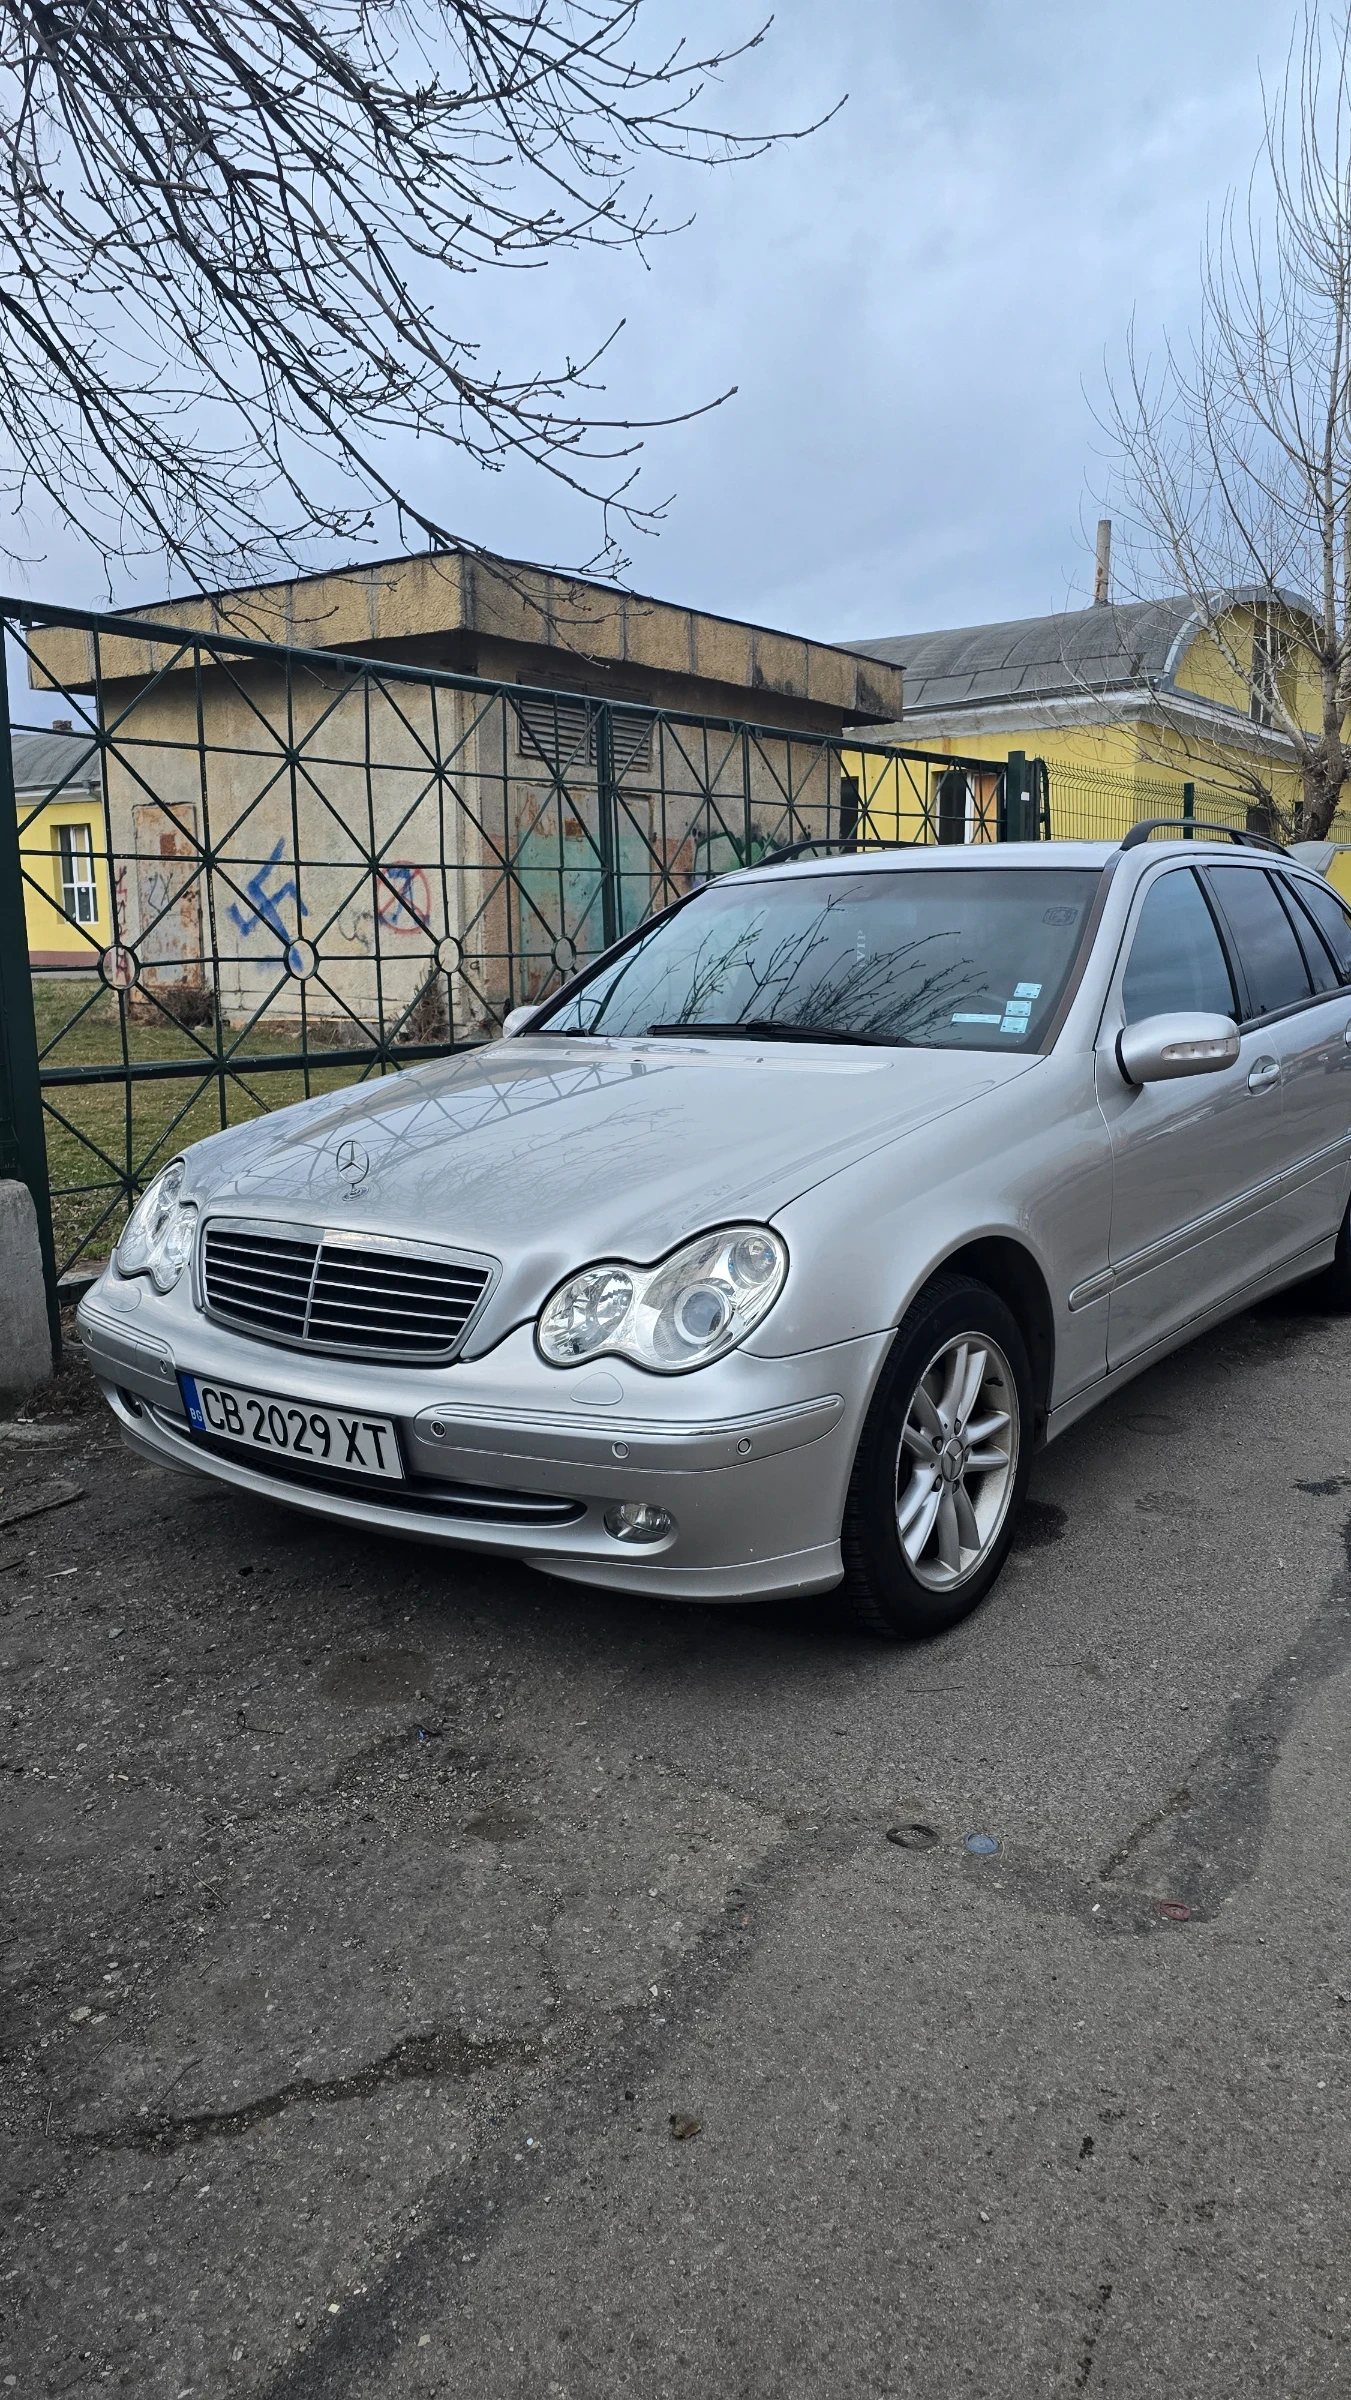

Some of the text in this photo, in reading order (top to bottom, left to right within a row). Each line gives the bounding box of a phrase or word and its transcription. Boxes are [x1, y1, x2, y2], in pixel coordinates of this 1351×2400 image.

[189, 1407, 203, 1422] BG
[201, 1387, 387, 1470] CB 2029 XT
